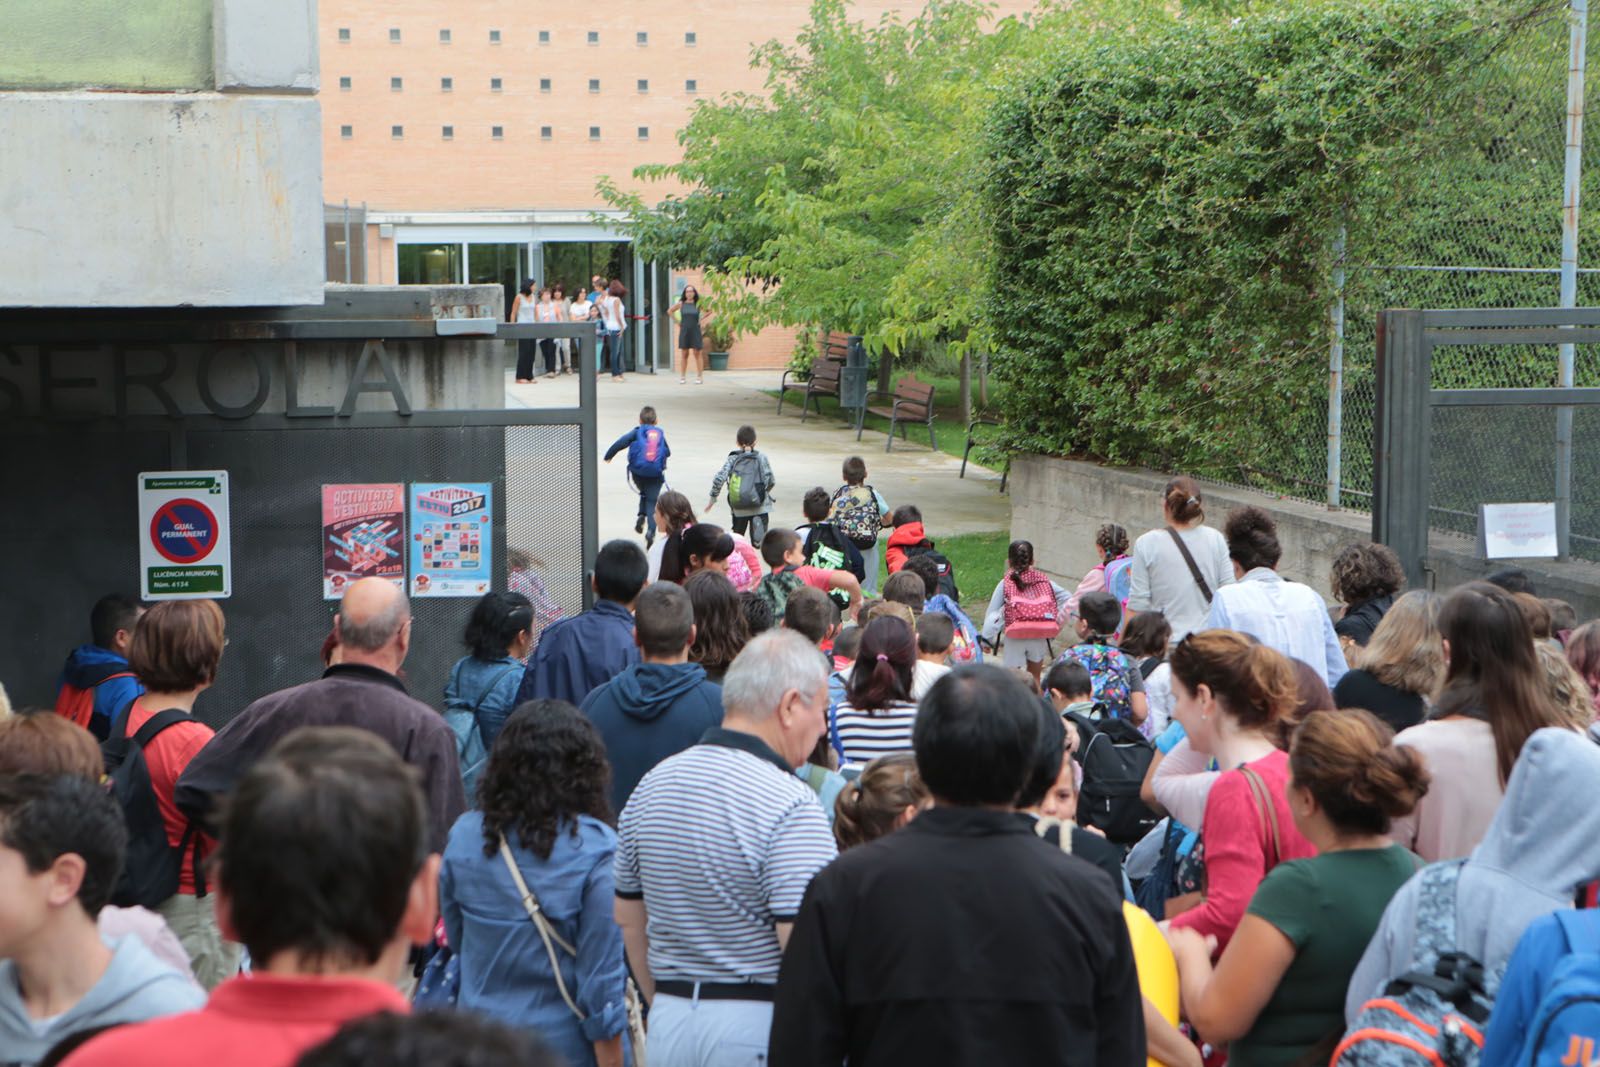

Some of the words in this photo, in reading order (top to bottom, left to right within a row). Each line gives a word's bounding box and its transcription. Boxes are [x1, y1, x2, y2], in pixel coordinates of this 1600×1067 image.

[334, 488, 395, 505] ACTIVITATS
[430, 488, 473, 500] ACTIVITATS
[333, 502, 369, 518] D'ESTIU
[371, 500, 394, 512] 2017
[419, 499, 450, 513] ESTIU
[453, 497, 484, 514] 2017
[161, 530, 207, 538] PERMANENT
[185, 569, 219, 577] MUNICIPAL
